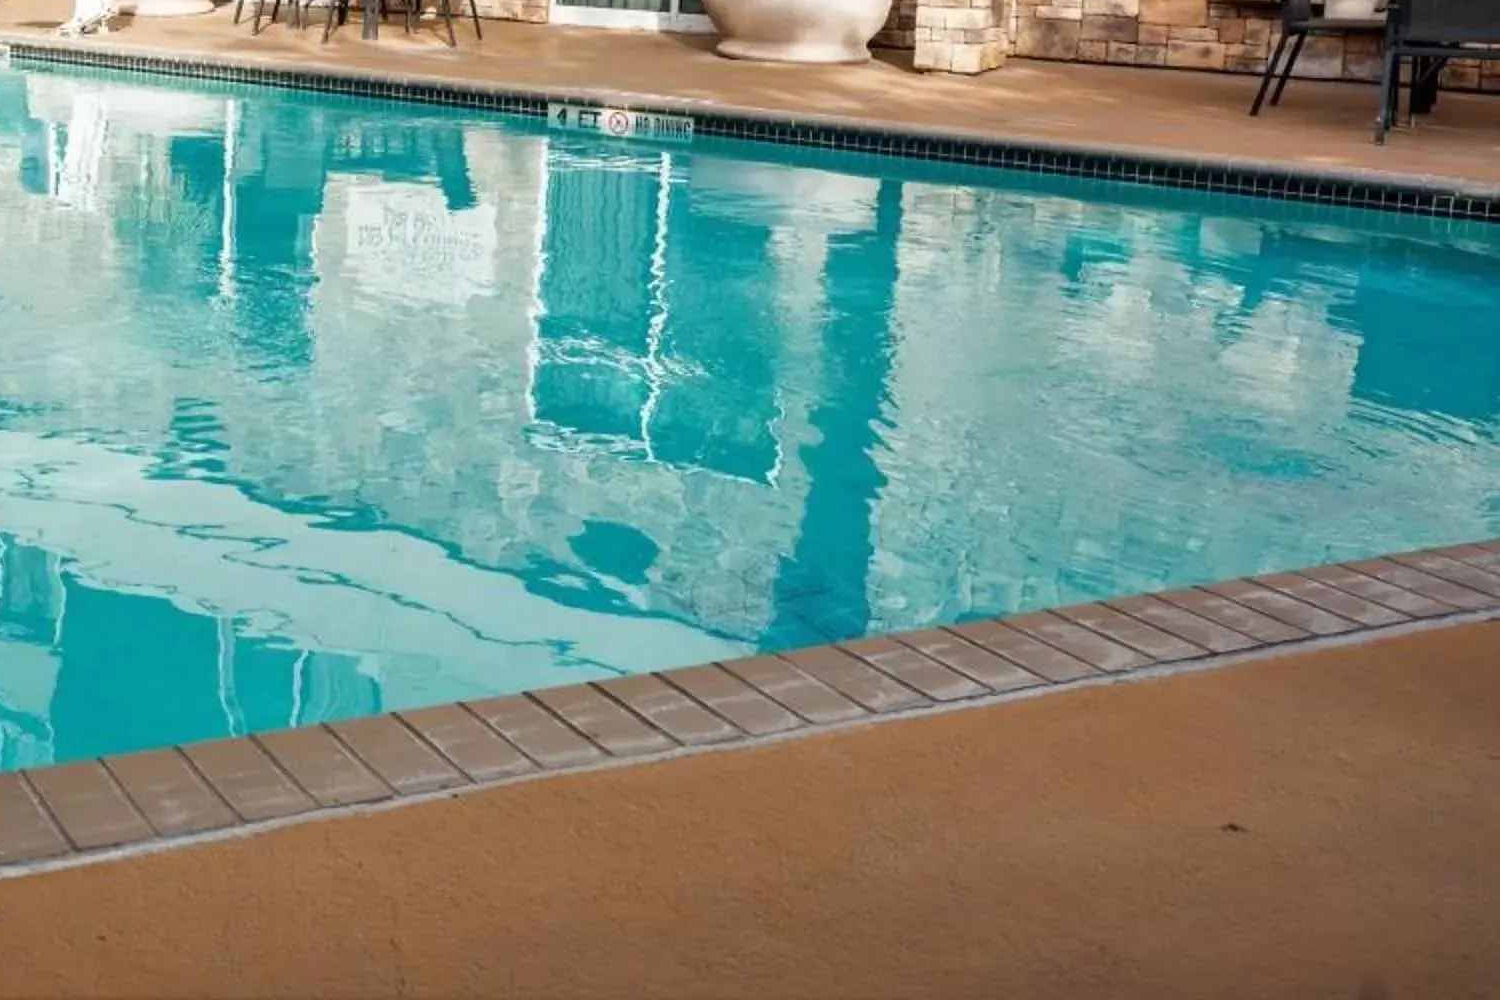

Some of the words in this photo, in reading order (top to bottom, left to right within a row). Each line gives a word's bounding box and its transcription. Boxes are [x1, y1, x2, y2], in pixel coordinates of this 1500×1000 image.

[557, 107, 567, 126] 4
[578, 110, 602, 130] FT
[635, 115, 651, 133] NO
[655, 117, 692, 140] DIVING
